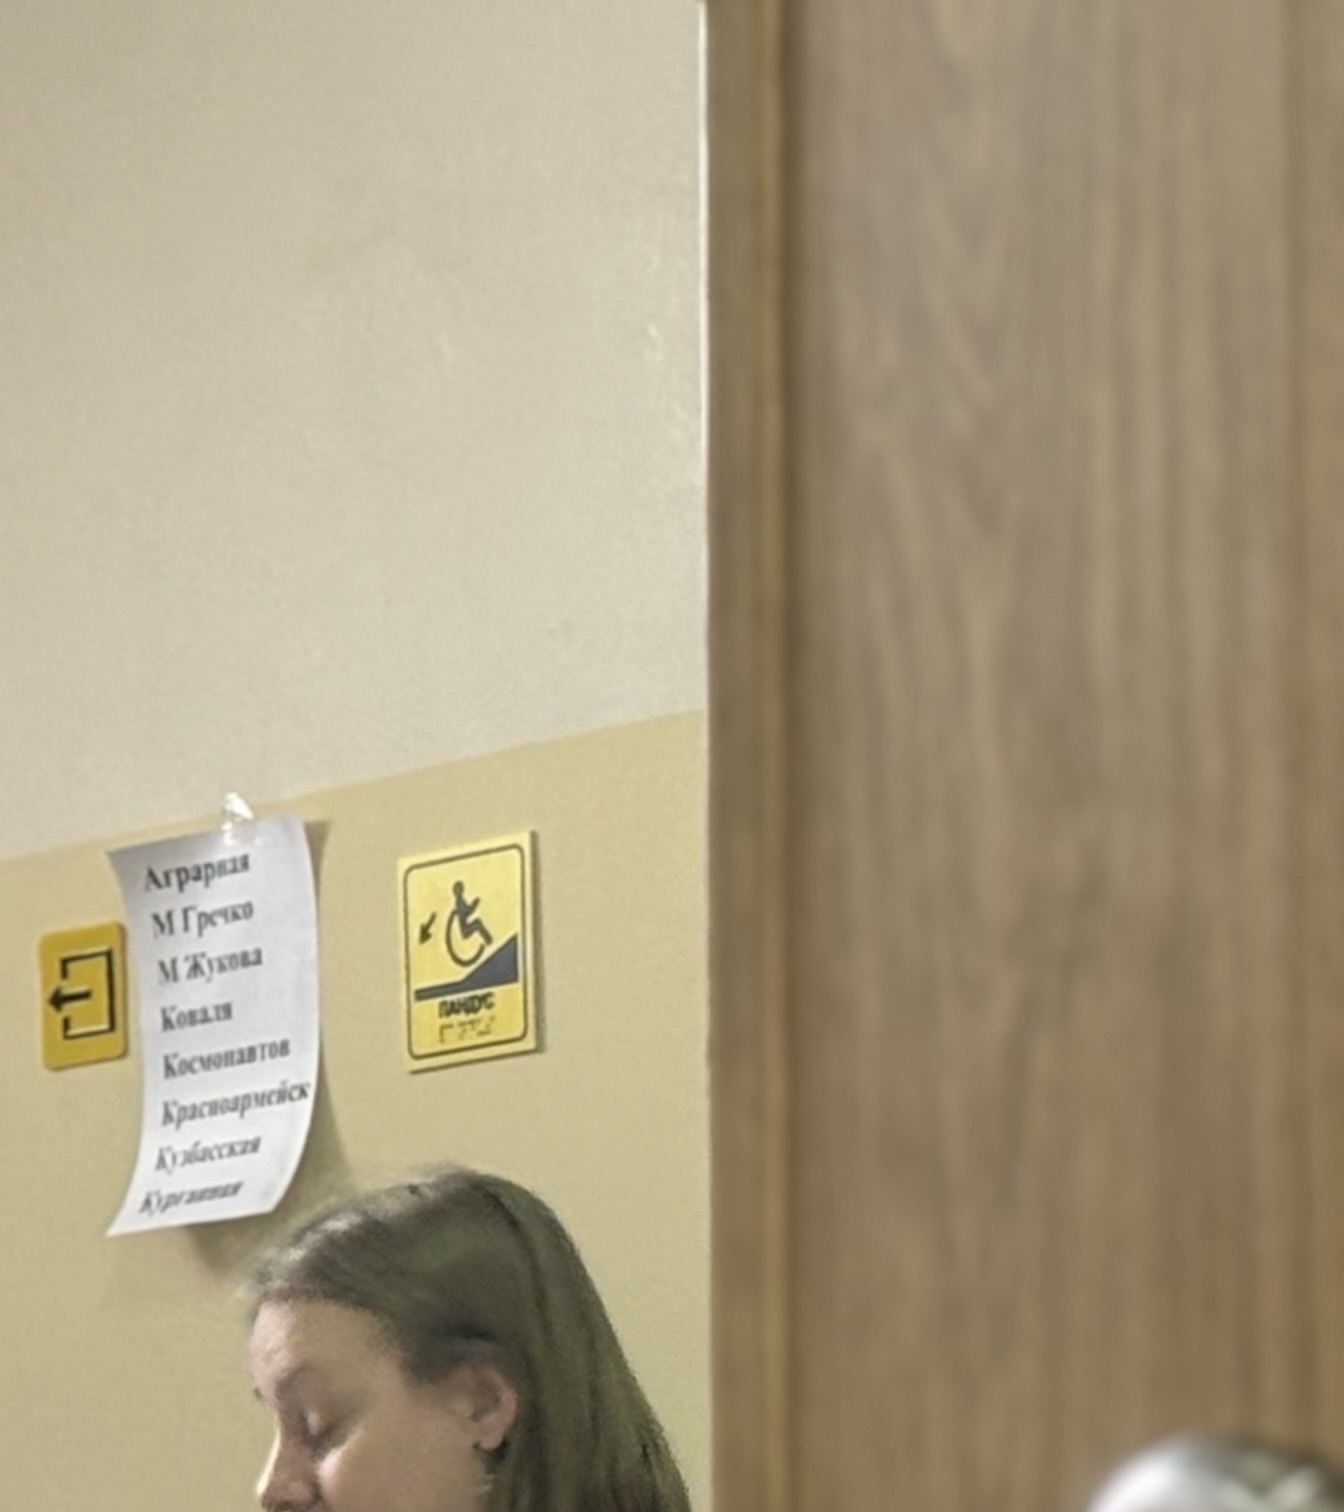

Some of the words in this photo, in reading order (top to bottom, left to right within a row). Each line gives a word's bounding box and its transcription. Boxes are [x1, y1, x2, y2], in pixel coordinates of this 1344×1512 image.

[144, 854, 251, 892] Аграрная
[151, 909, 175, 939] М
[182, 901, 254, 937] Гречко
[158, 956, 179, 985] М
[183, 948, 263, 983] Жукова
[161, 1001, 234, 1034] Коваля
[438, 991, 495, 1019] ПАНДУС
[163, 1039, 290, 1079] Космонавтов
[161, 1079, 311, 1130] Красноармейск
[154, 1137, 262, 1176] Кузбасская
